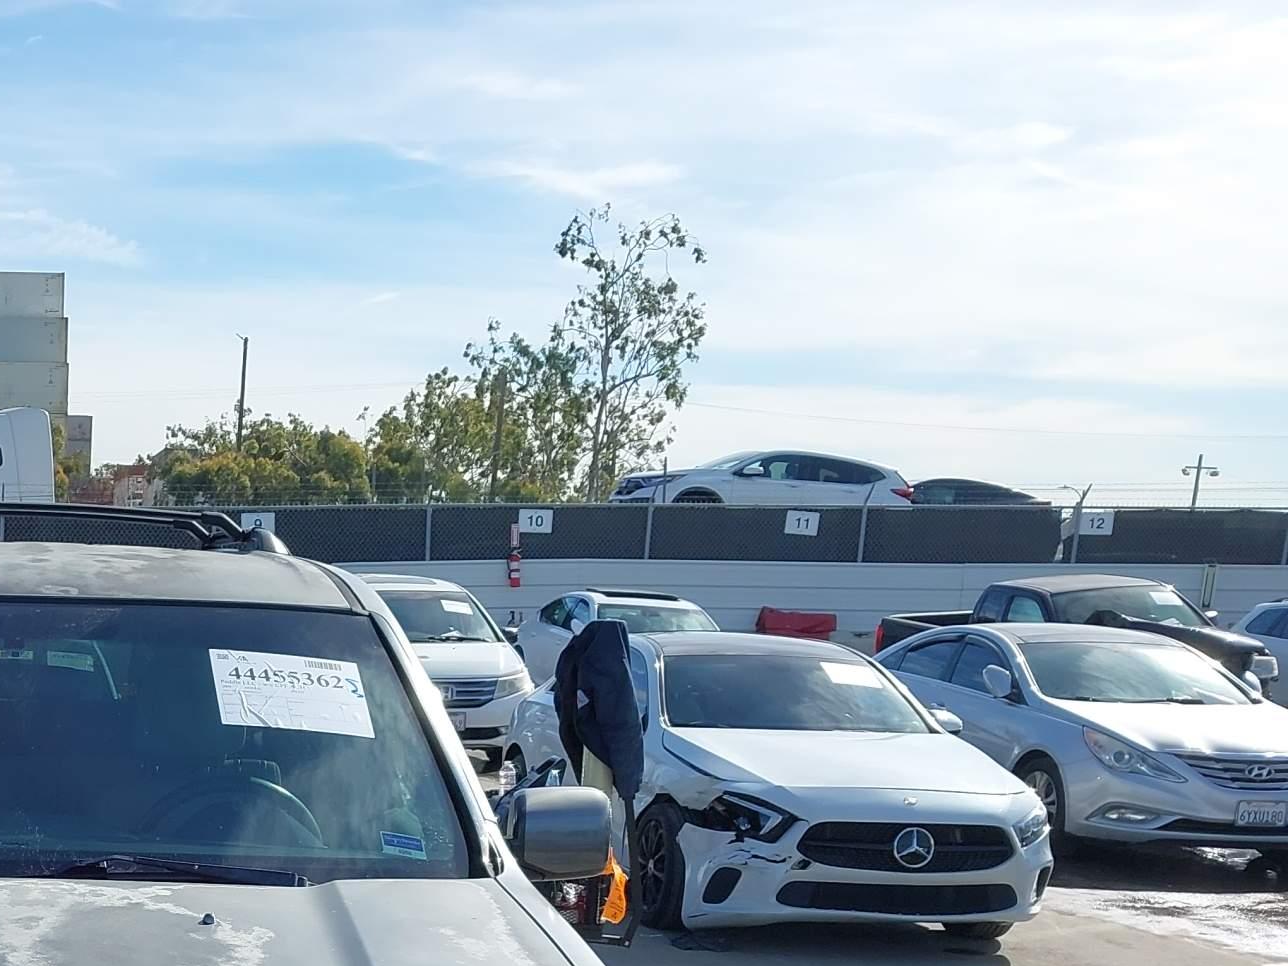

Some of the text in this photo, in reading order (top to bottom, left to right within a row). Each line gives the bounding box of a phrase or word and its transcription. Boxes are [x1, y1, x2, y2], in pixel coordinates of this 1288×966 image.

[527, 515, 544, 528] 10
[795, 516, 810, 530] 11
[1089, 517, 1105, 530] 12
[228, 666, 344, 690] 44455362
